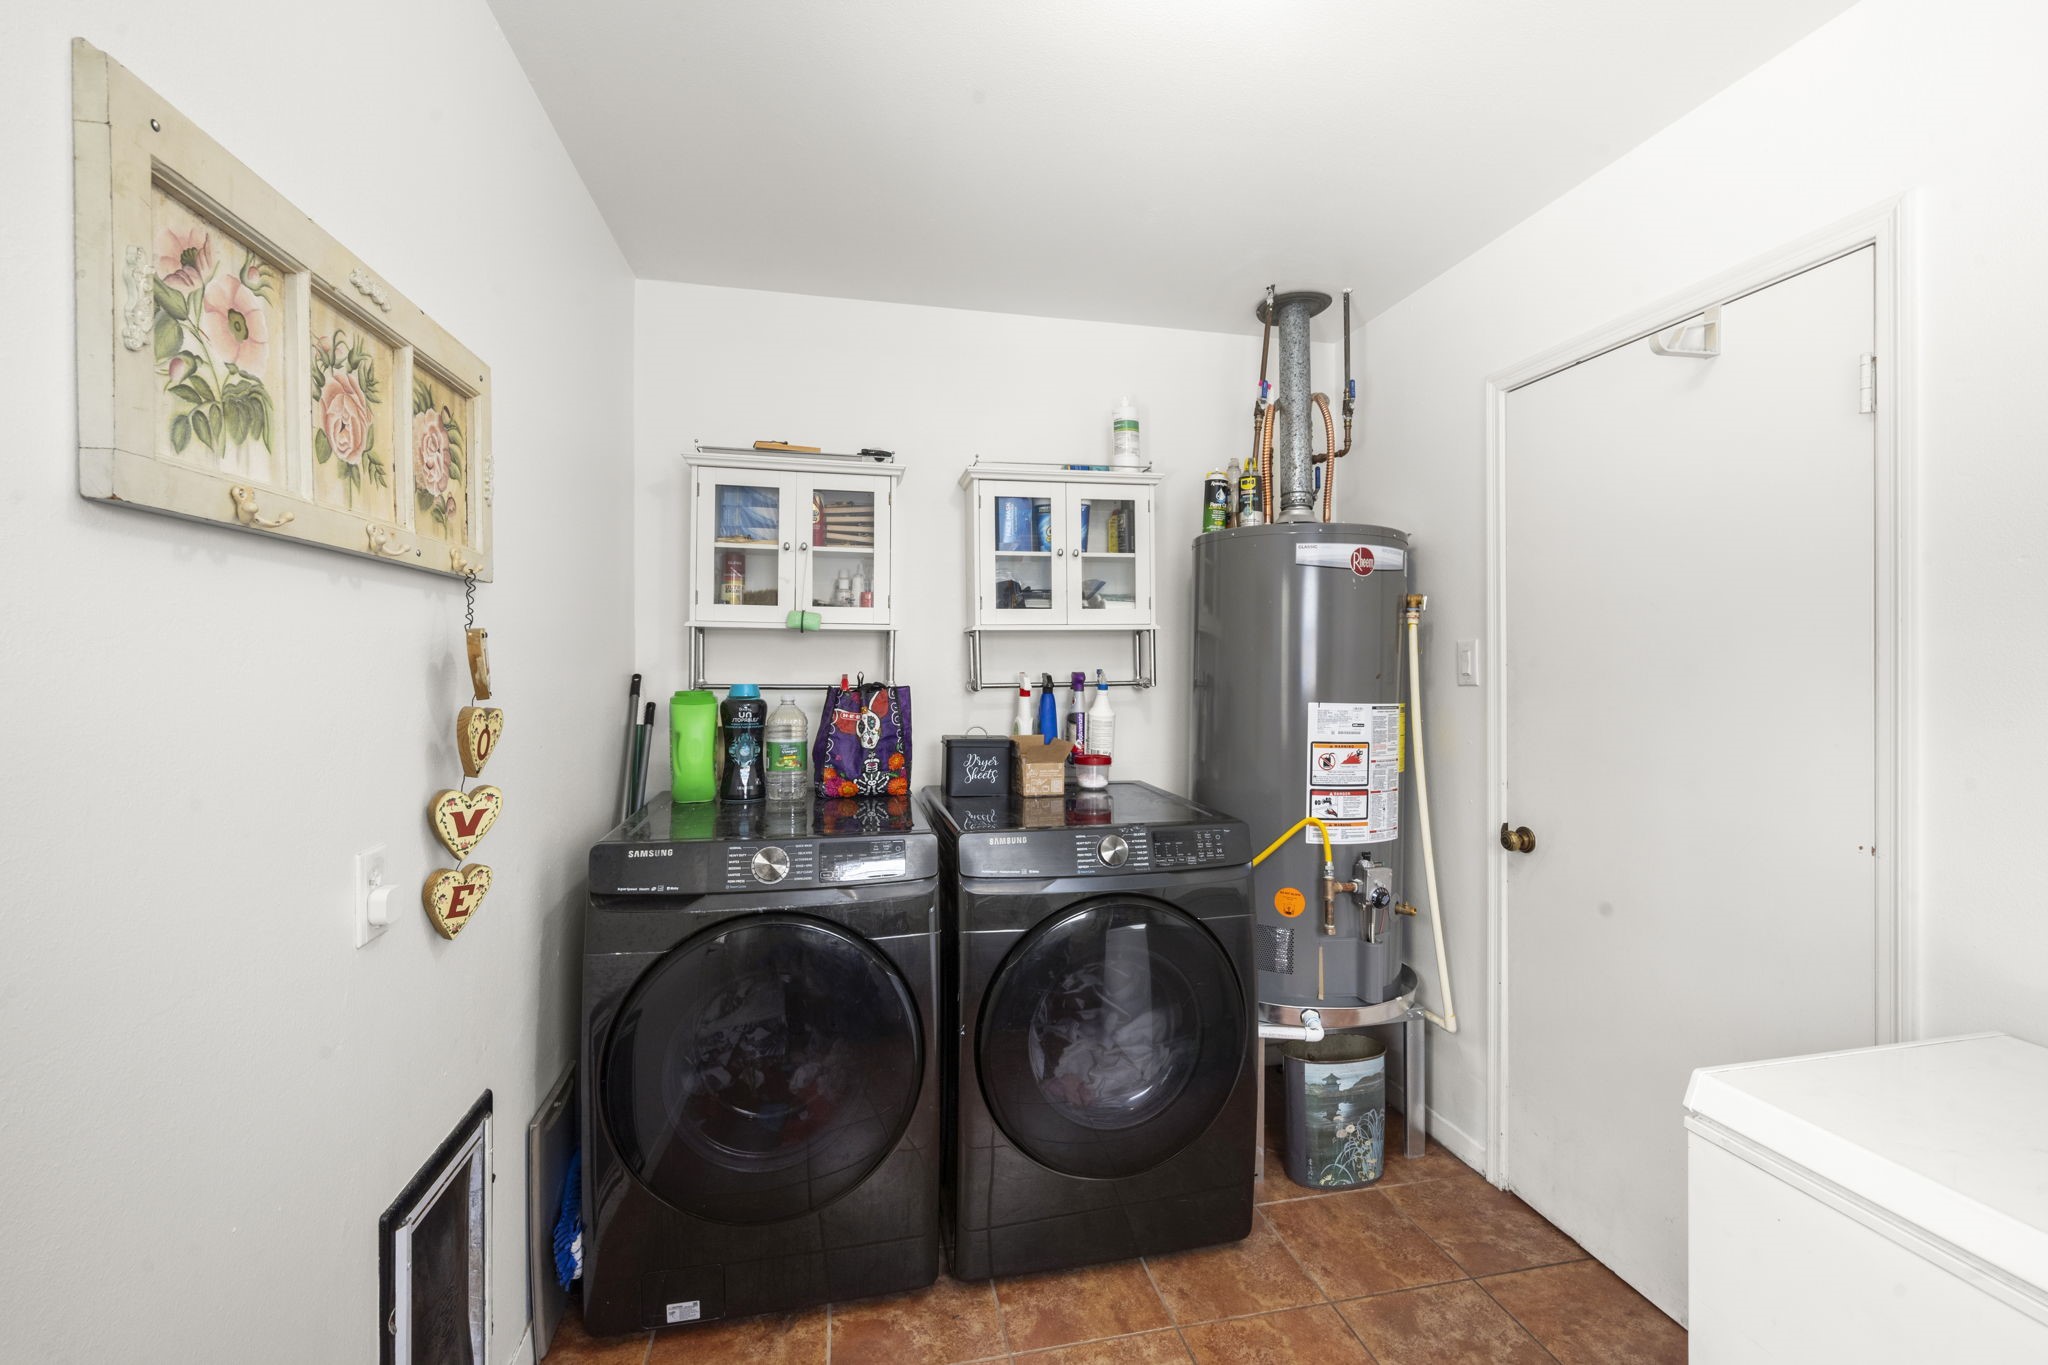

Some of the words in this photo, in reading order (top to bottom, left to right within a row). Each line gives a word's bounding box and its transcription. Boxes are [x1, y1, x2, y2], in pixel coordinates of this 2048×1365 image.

[1353, 547, 1374, 572] Rheem
[963, 753, 999, 772] Dryer
[964, 766, 999, 784] Sheets
[449, 807, 490, 838] V
[989, 836, 1028, 846] SAMSUNG
[628, 849, 673, 858] SAMSUNG
[445, 883, 475, 920] E
